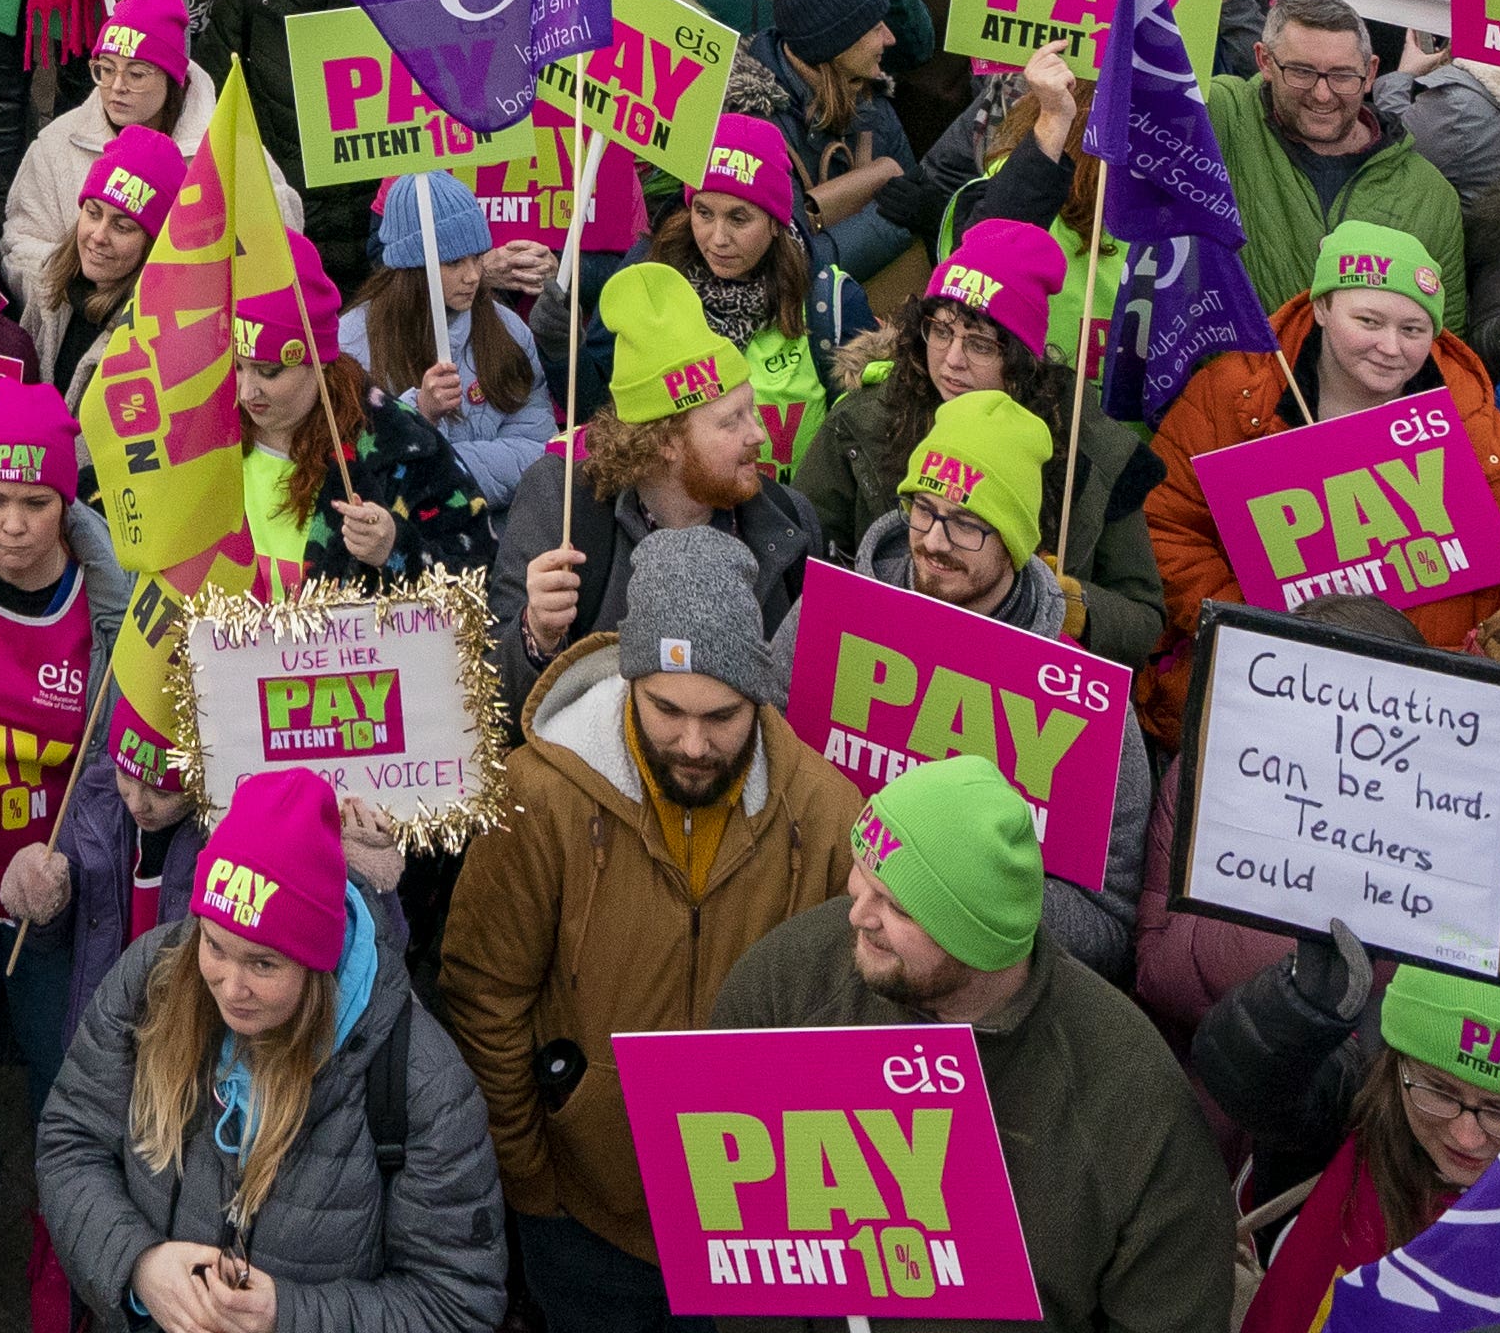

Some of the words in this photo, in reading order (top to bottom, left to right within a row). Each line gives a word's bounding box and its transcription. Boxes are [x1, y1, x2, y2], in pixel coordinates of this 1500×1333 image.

[1388, 404, 1451, 447] eis
[1246, 446, 1455, 583] PAY
[281, 650, 330, 671] USE
[339, 648, 382, 667] HER
[263, 670, 396, 728] PAY
[1248, 651, 1486, 746] Calculating
[1237, 742, 1312, 793] can
[1336, 754, 1387, 804] be
[1335, 713, 1422, 774] 10%
[366, 758, 465, 794] VOICE!
[1282, 791, 1435, 873] Teachers
[1213, 846, 1317, 896] could
[1364, 867, 1435, 918] help
[882, 1044, 966, 1095] eis
[676, 1107, 955, 1234] PAY
